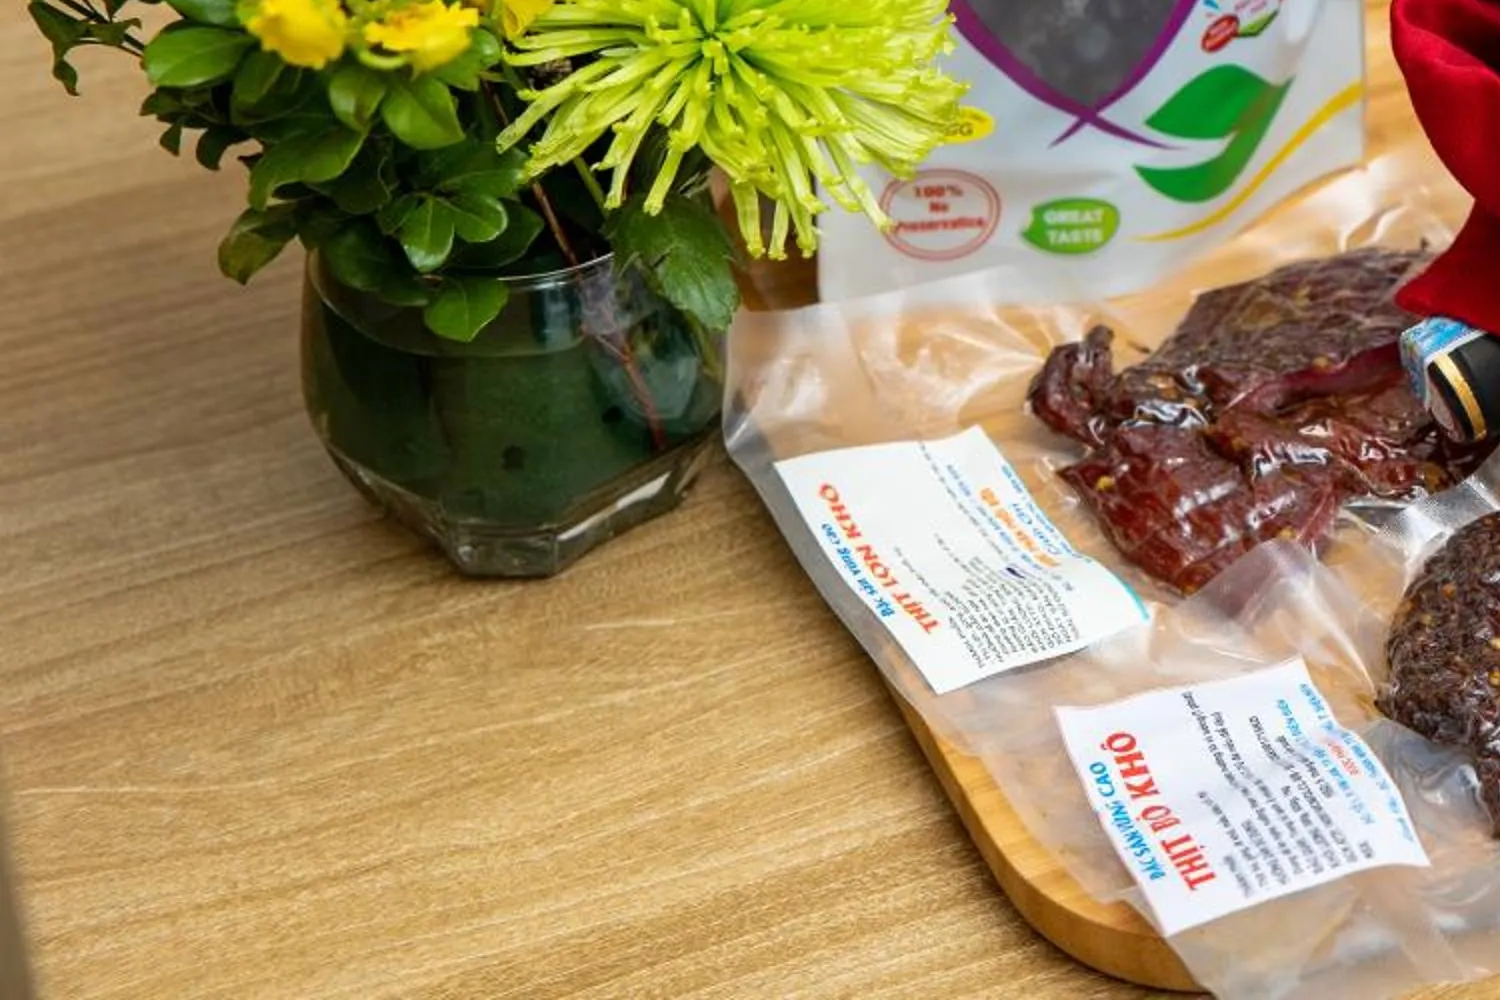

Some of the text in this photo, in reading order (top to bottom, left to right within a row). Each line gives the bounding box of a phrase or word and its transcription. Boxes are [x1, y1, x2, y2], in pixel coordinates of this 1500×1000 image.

[913, 184, 964, 199] 100%
[1043, 208, 1106, 226] GREAT
[1047, 228, 1105, 244] TASTE
[1089, 760, 1115, 797] CAO
[1099, 730, 1217, 892] THỊT BÒ KHÔ
